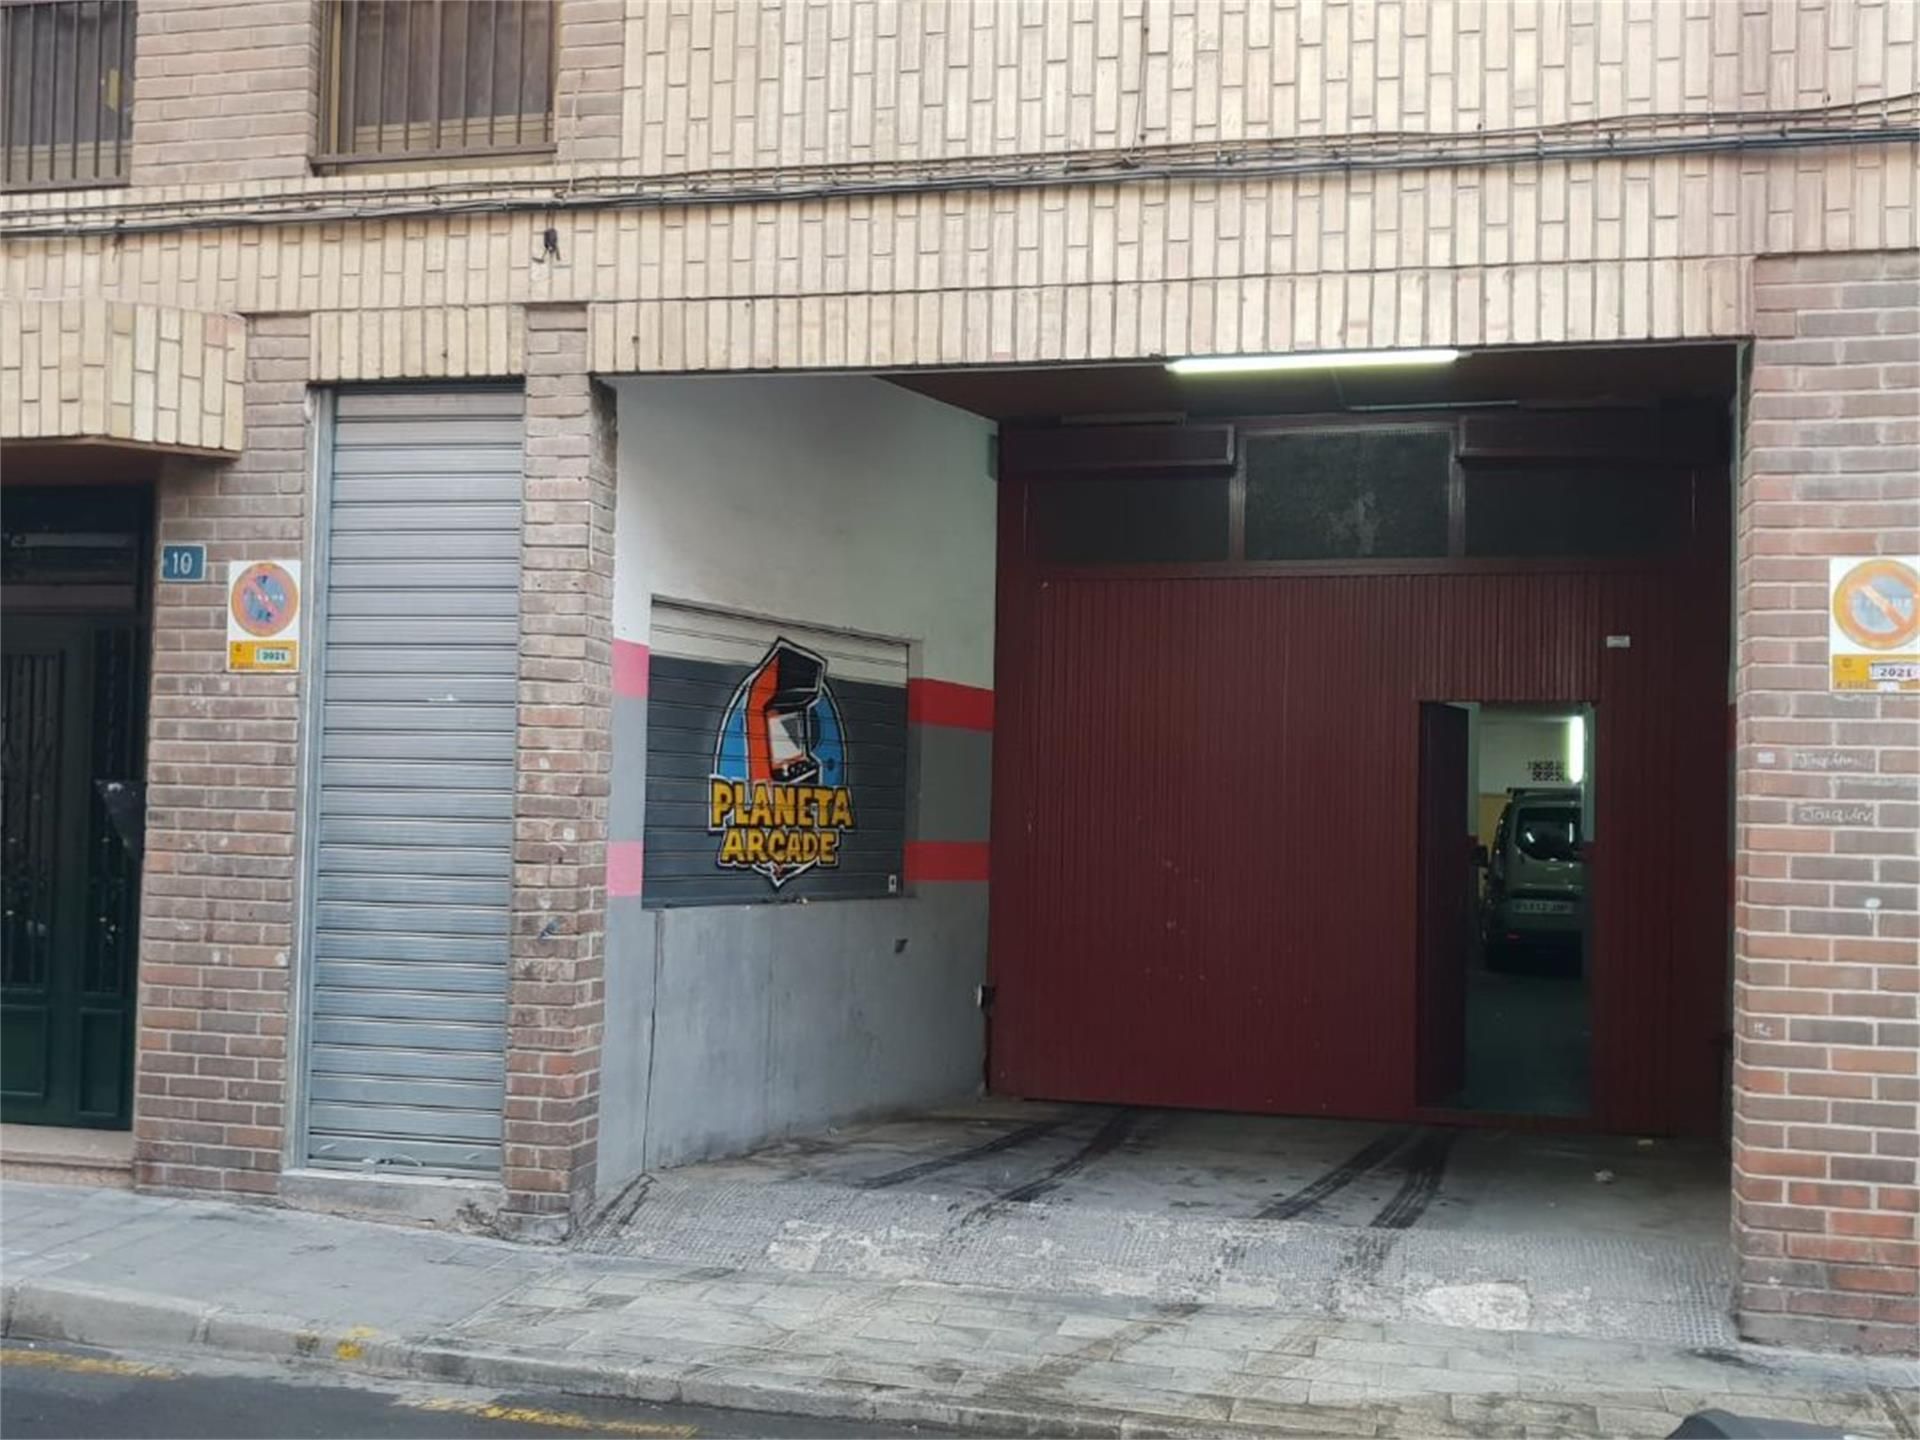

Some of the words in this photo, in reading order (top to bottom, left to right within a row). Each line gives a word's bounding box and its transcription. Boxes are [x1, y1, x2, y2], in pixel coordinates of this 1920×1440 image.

[172, 551, 193, 575] 10
[1879, 667, 1912, 678] 2021
[709, 778, 854, 829] PLANETA
[719, 828, 837, 866] ARCADE
